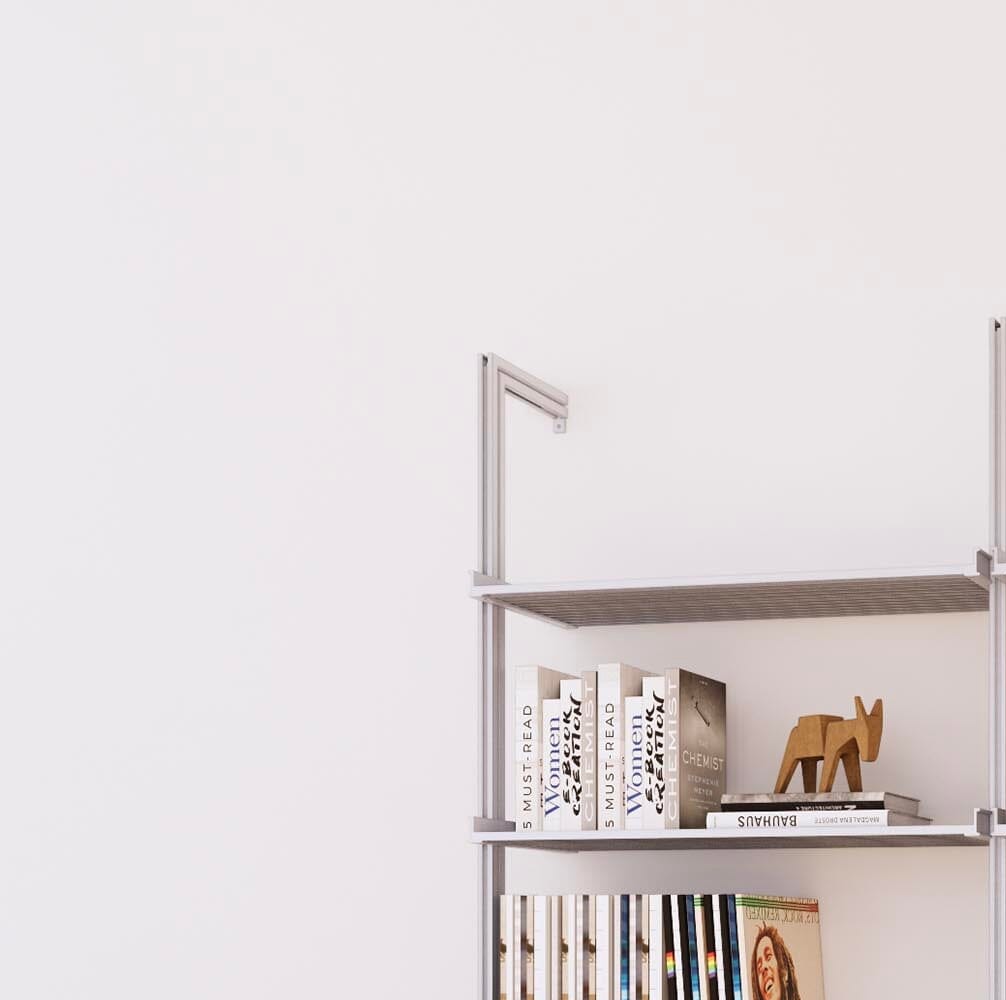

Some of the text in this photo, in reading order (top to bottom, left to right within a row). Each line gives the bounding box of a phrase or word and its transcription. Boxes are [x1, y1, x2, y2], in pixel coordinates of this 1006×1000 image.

[522, 705, 532, 829] 5 MUST-READ
[544, 717, 560, 816] Women
[562, 706, 573, 803] E-BOOK
[570, 691, 582, 816] CREATION
[584, 680, 593, 822] CHEMIST
[605, 703, 615, 828] 5 MUST-READ
[626, 714, 642, 815] Women
[645, 704, 655, 803] E-BOOK
[653, 690, 666, 814] CREATION
[668, 678, 678, 820] CHEMIST
[682, 750, 725, 772] CHEMIST
[737, 815, 797, 827] BAUHAUS
[814, 816, 880, 824] MAGDALENA DROSTE
